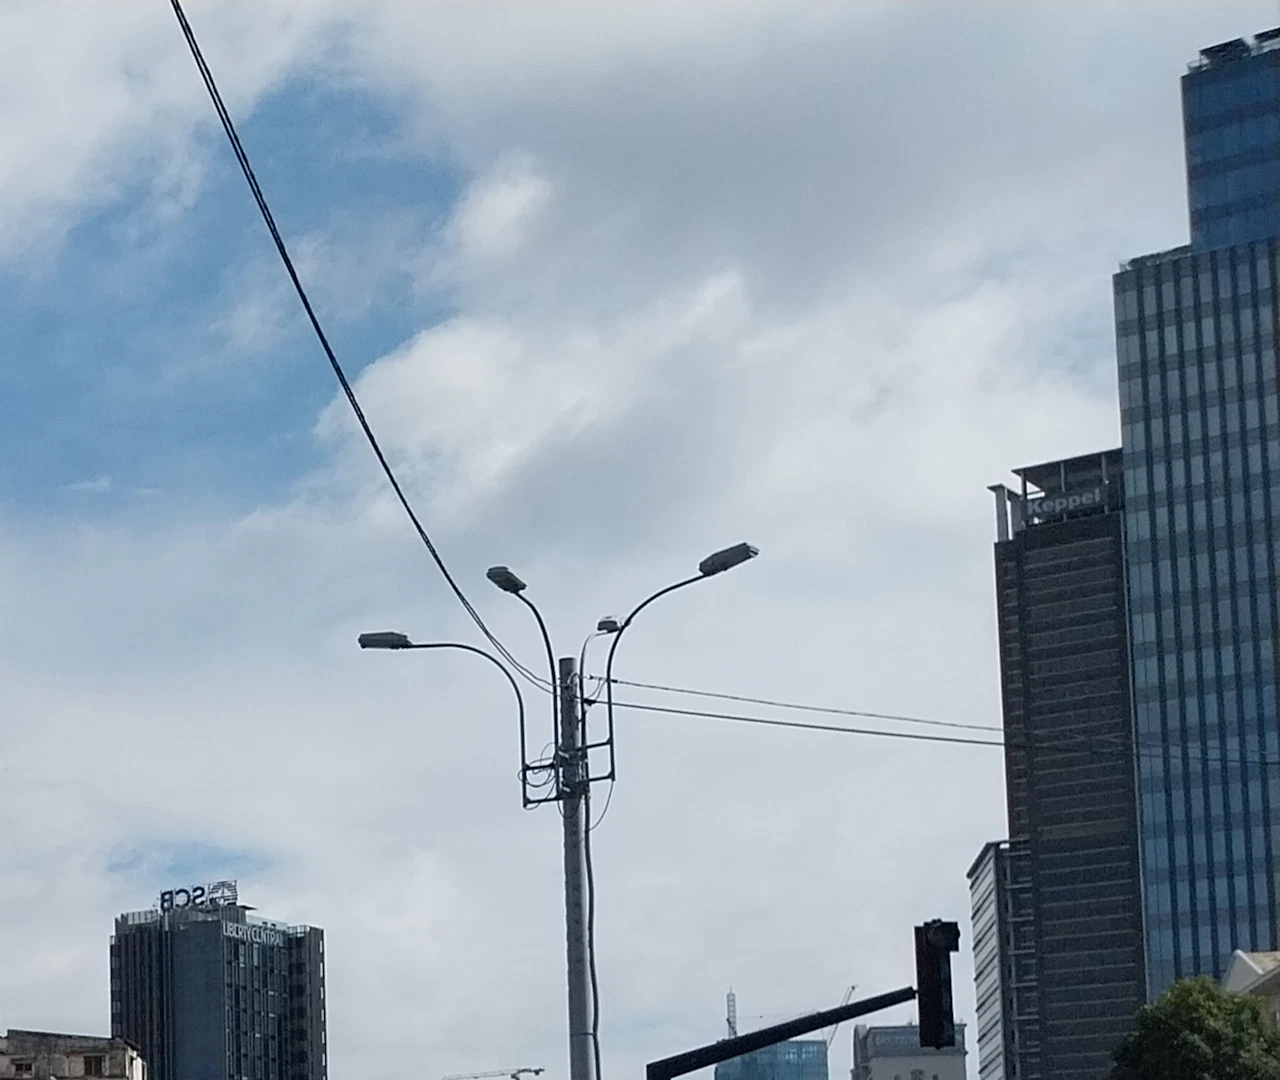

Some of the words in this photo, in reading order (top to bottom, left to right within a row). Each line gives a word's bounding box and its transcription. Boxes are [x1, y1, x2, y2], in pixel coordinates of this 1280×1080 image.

[1027, 488, 1101, 515] Keppel
[222, 921, 251, 943] LIBERTY
[251, 926, 285, 947] CENTRAL
